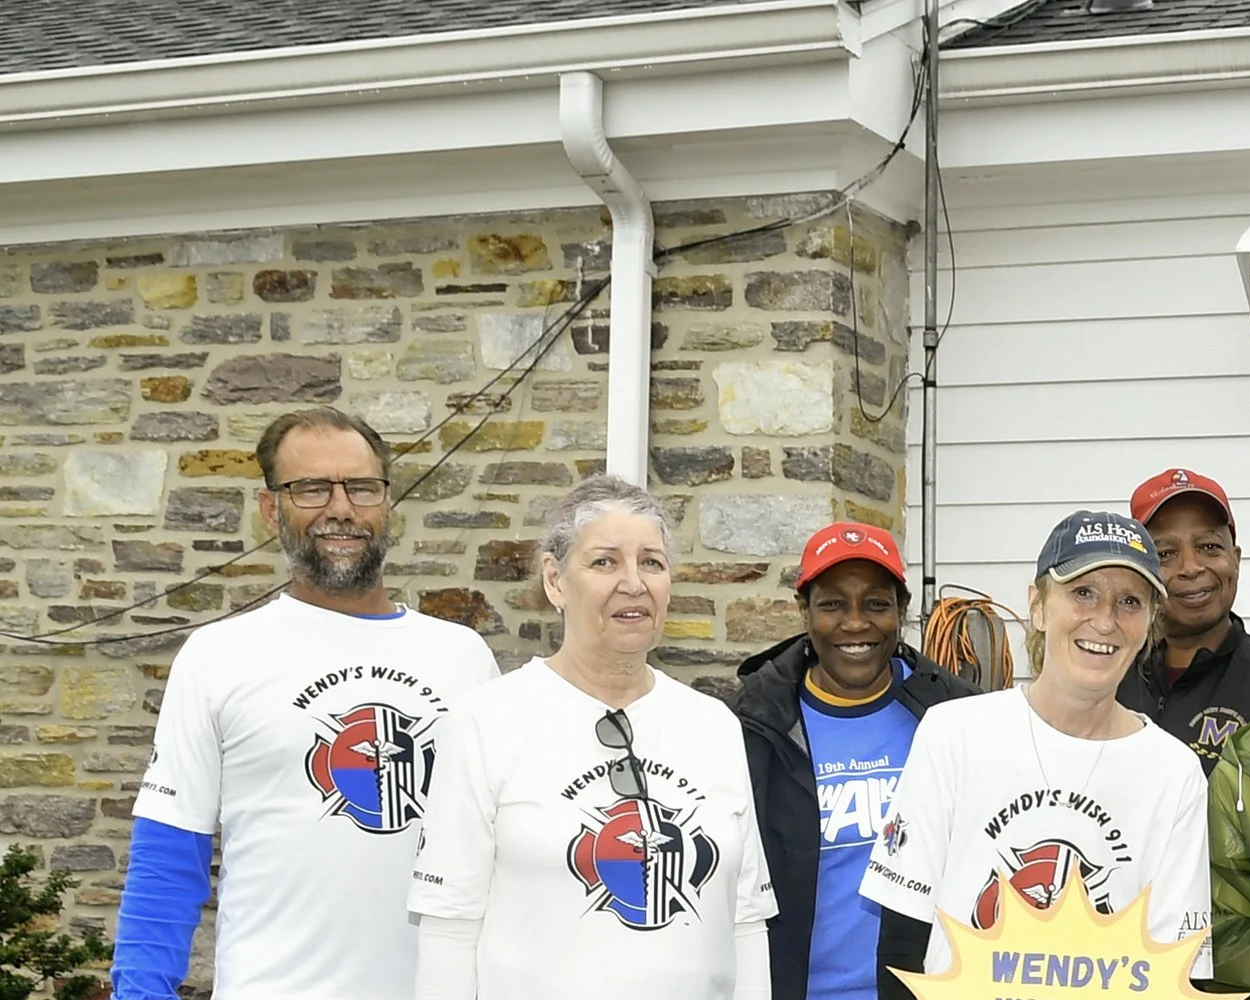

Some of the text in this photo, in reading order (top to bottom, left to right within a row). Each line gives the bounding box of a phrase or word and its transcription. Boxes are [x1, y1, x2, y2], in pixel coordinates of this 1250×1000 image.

[1075, 532, 1129, 546] Foundation
[1079, 522, 1142, 544] ALS Hope
[292, 665, 449, 713] WENDY'S WISH 911
[817, 754, 890, 774] 19th Annual
[677, 777, 706, 801] 911
[984, 789, 1133, 863] WENDY'S WISH 911
[1179, 910, 1208, 931] ALS
[992, 951, 1151, 993] WENDY'S
